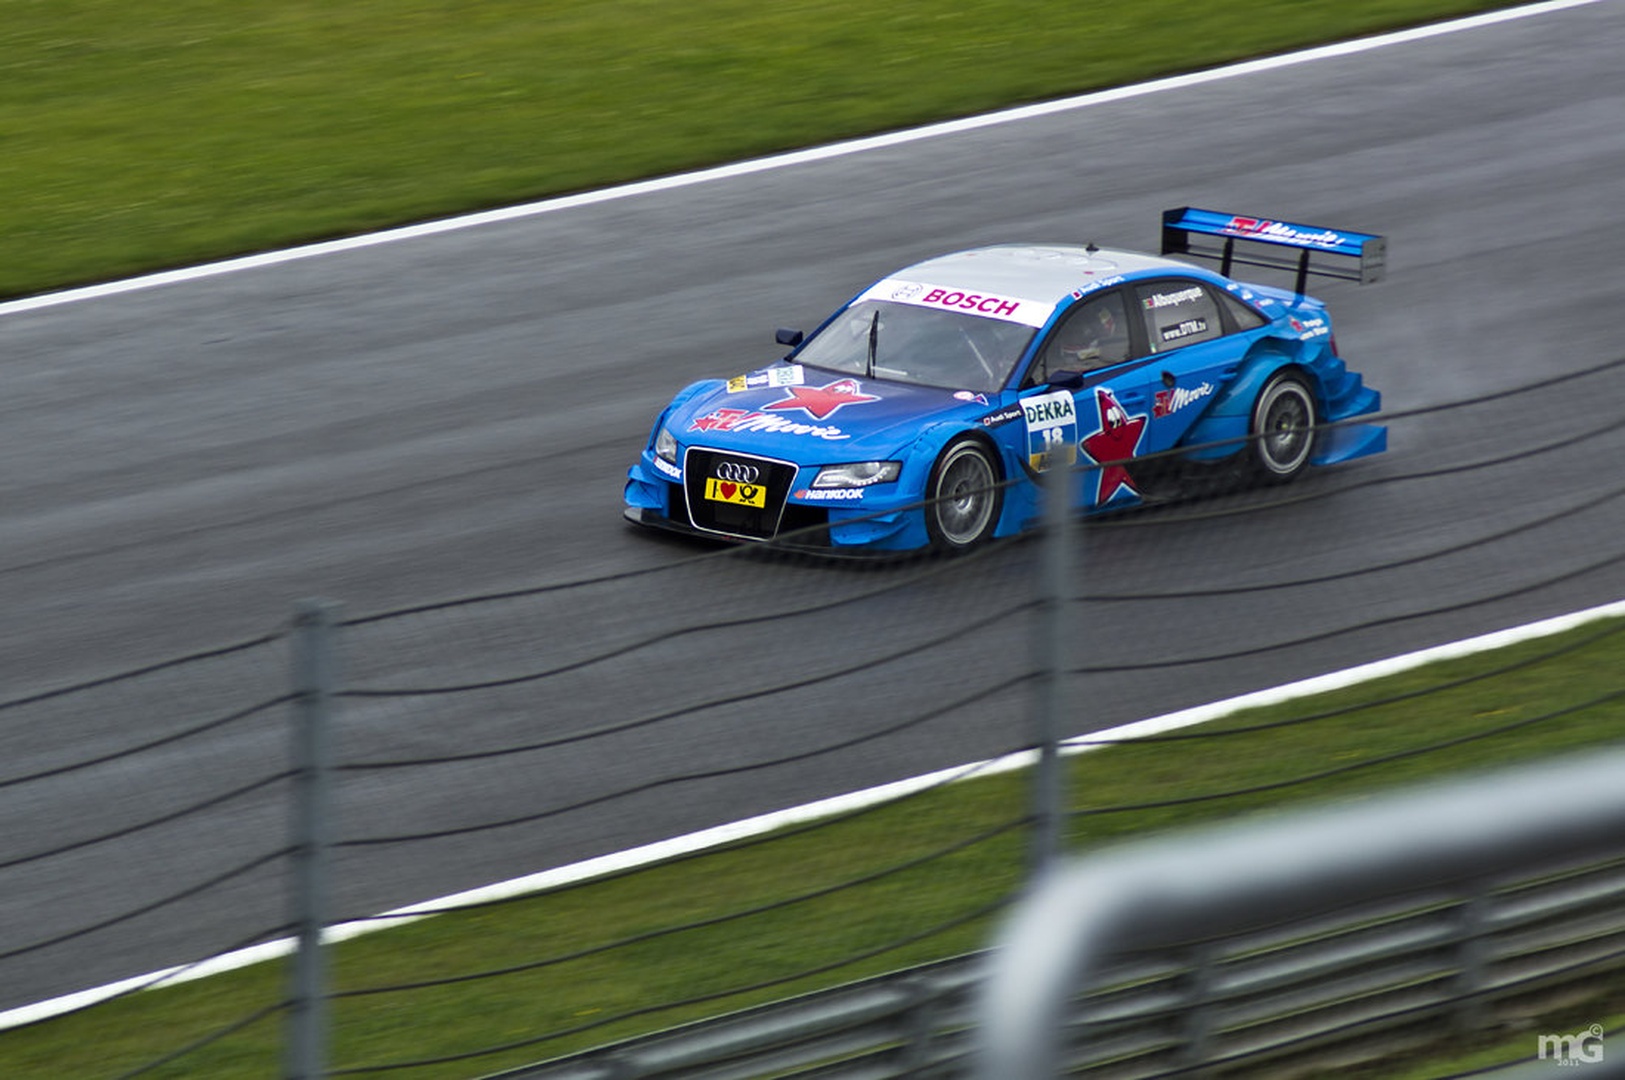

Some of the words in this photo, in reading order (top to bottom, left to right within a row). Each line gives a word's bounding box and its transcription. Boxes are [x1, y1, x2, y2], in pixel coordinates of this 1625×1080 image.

[922, 289, 1020, 316] BOSCH
[1025, 400, 1073, 424] DEKRA
[1042, 427, 1064, 450] 18
